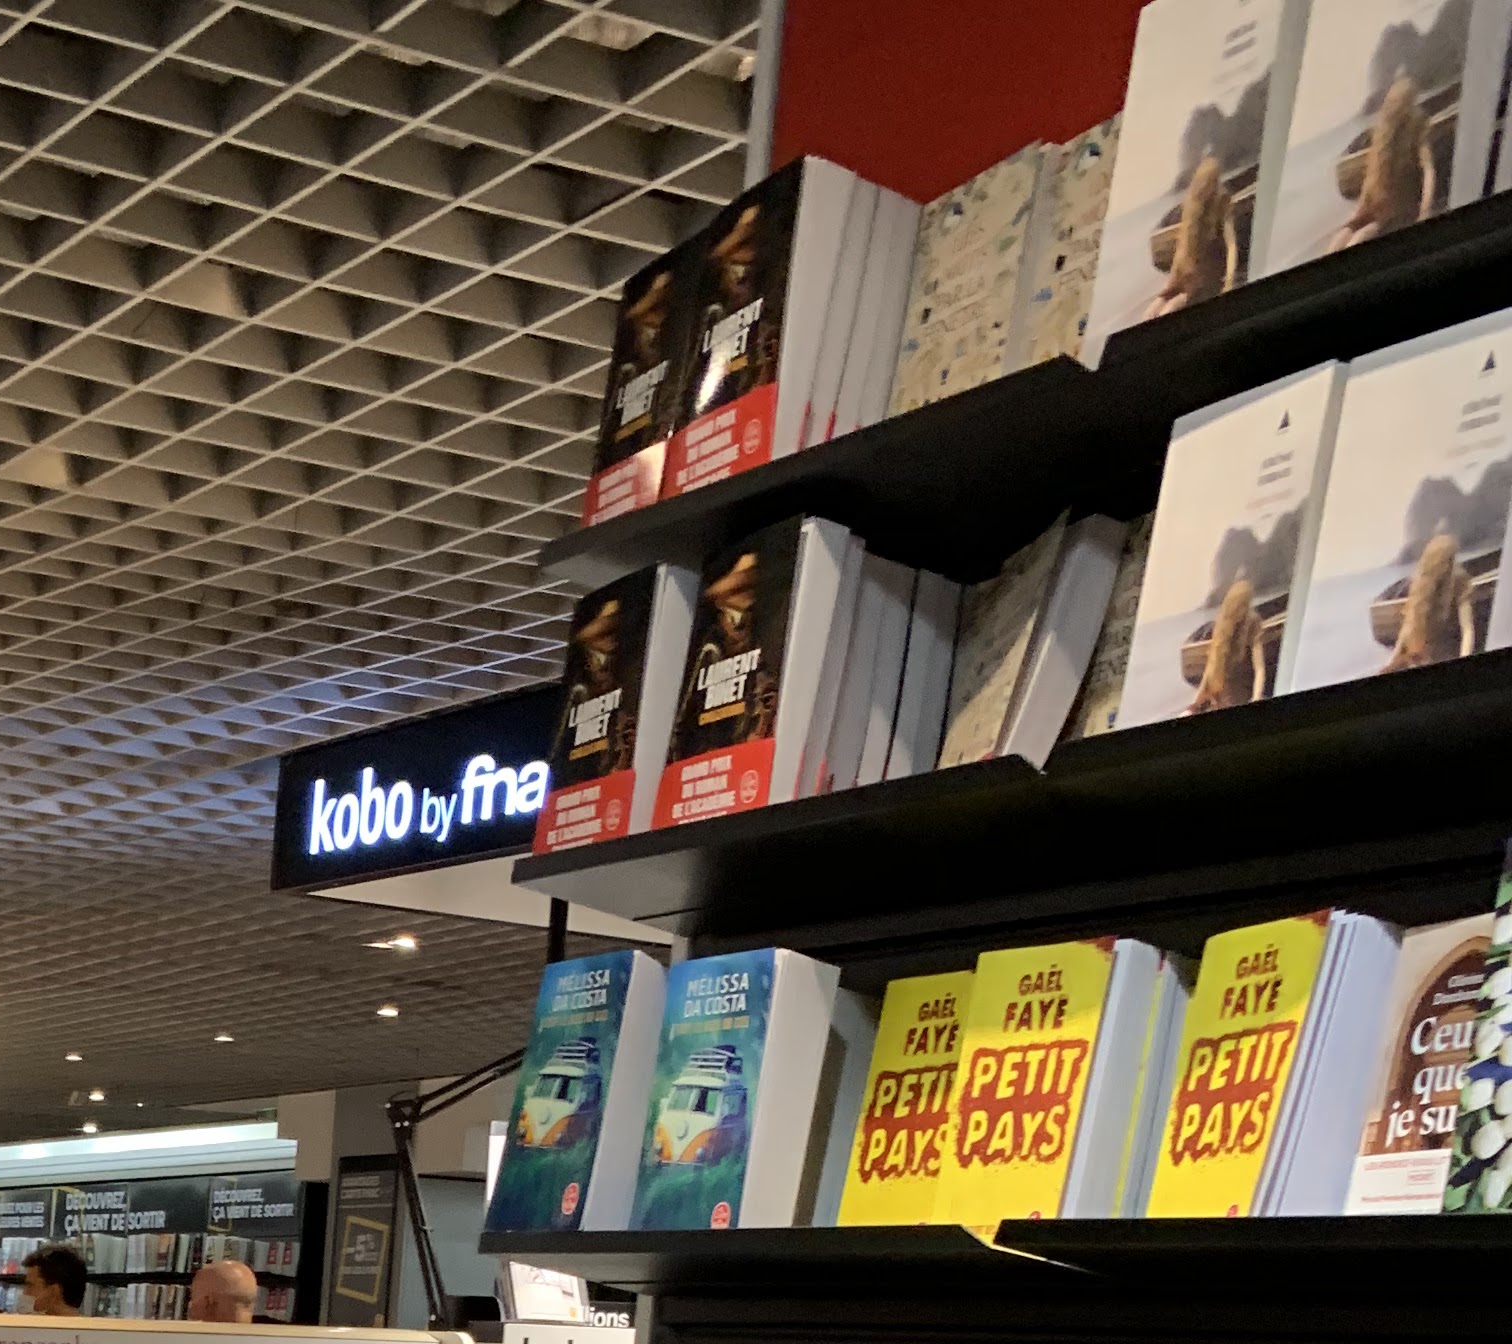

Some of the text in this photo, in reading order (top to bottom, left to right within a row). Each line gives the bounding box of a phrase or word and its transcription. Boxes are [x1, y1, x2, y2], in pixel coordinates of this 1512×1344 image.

[308, 754, 550, 856] kobo by fna
[1019, 963, 1064, 994] GAËL
[1236, 943, 1281, 980] GAËL
[684, 994, 746, 1018] DA COSTA
[1003, 993, 1069, 1033] FAYE
[1220, 979, 1282, 1019] FAYE
[904, 1018, 960, 1056] FAYE
[1411, 1017, 1473, 1055] Ceu
[971, 1045, 1087, 1100] PETIT
[1188, 1029, 1295, 1091] PETIT
[1413, 1062, 1466, 1104] que
[963, 1105, 1066, 1156] PAYS
[1179, 1092, 1269, 1152] PAYS
[1386, 1100, 1457, 1147] je su
[863, 1126, 949, 1172] PAYS
[66, 1191, 126, 1212] DÉCOUVREZ,
[65, 1214, 80, 1234] ÇA
[110, 1213, 125, 1231] DE
[128, 1211, 165, 1230] SORTIR
